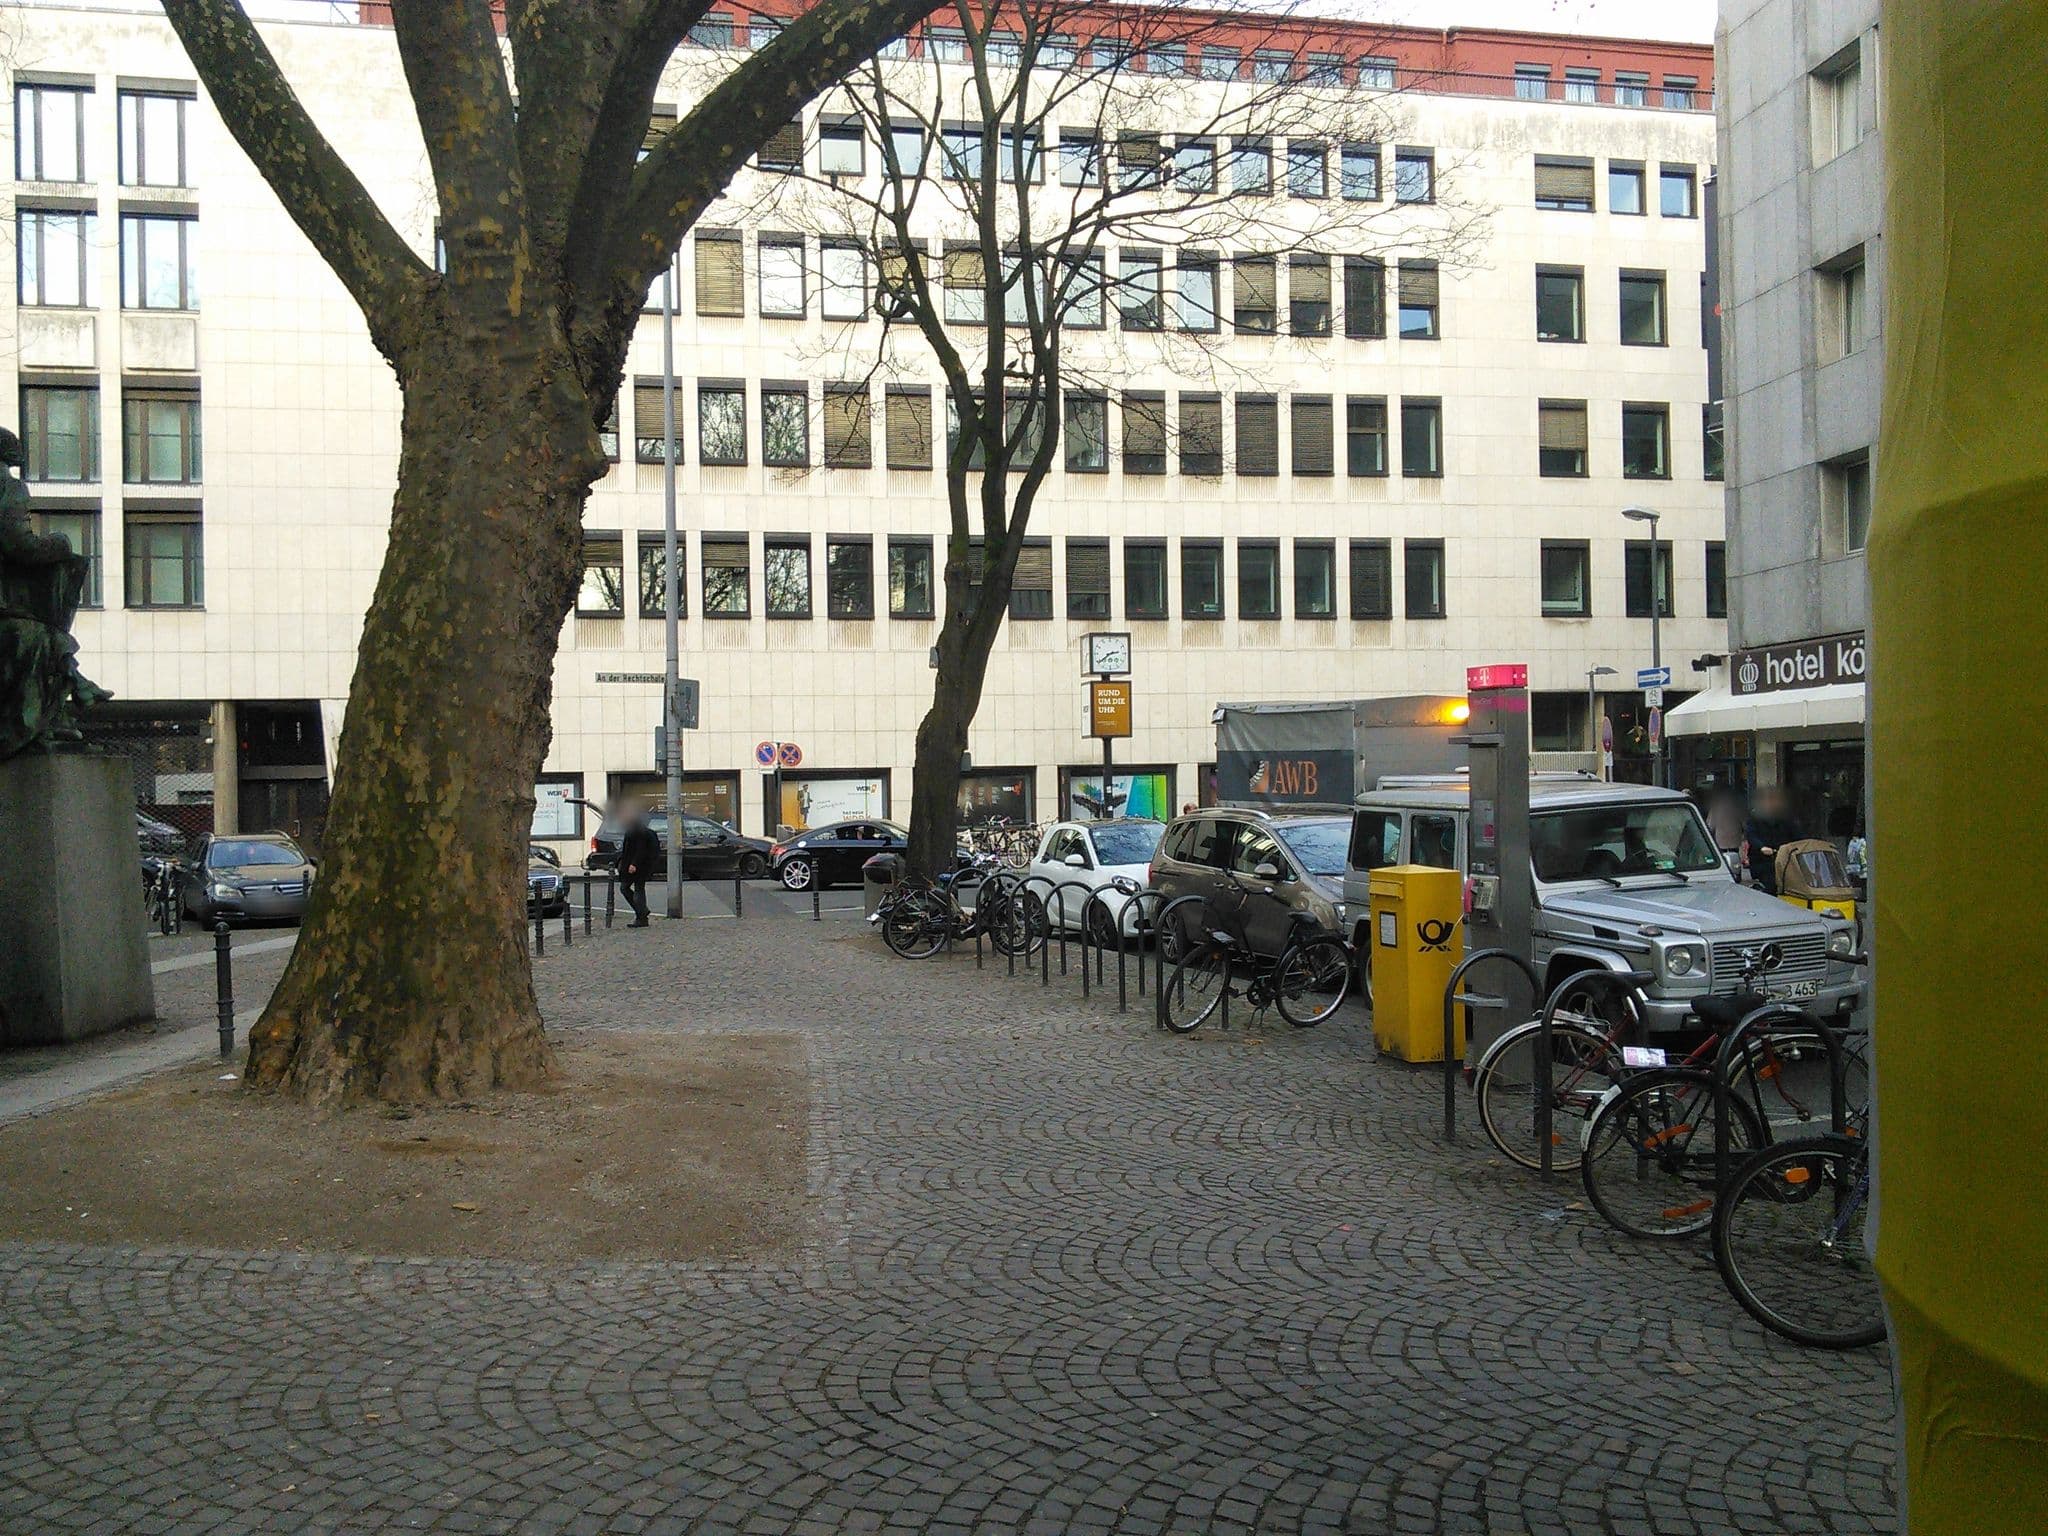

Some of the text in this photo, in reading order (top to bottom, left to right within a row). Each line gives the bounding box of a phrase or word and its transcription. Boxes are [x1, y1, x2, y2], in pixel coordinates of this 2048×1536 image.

[1766, 645, 1825, 685] hotel
[1097, 689, 1121, 697] RUND
[1271, 761, 1318, 795] AWB
[1795, 982, 1816, 997] 463
